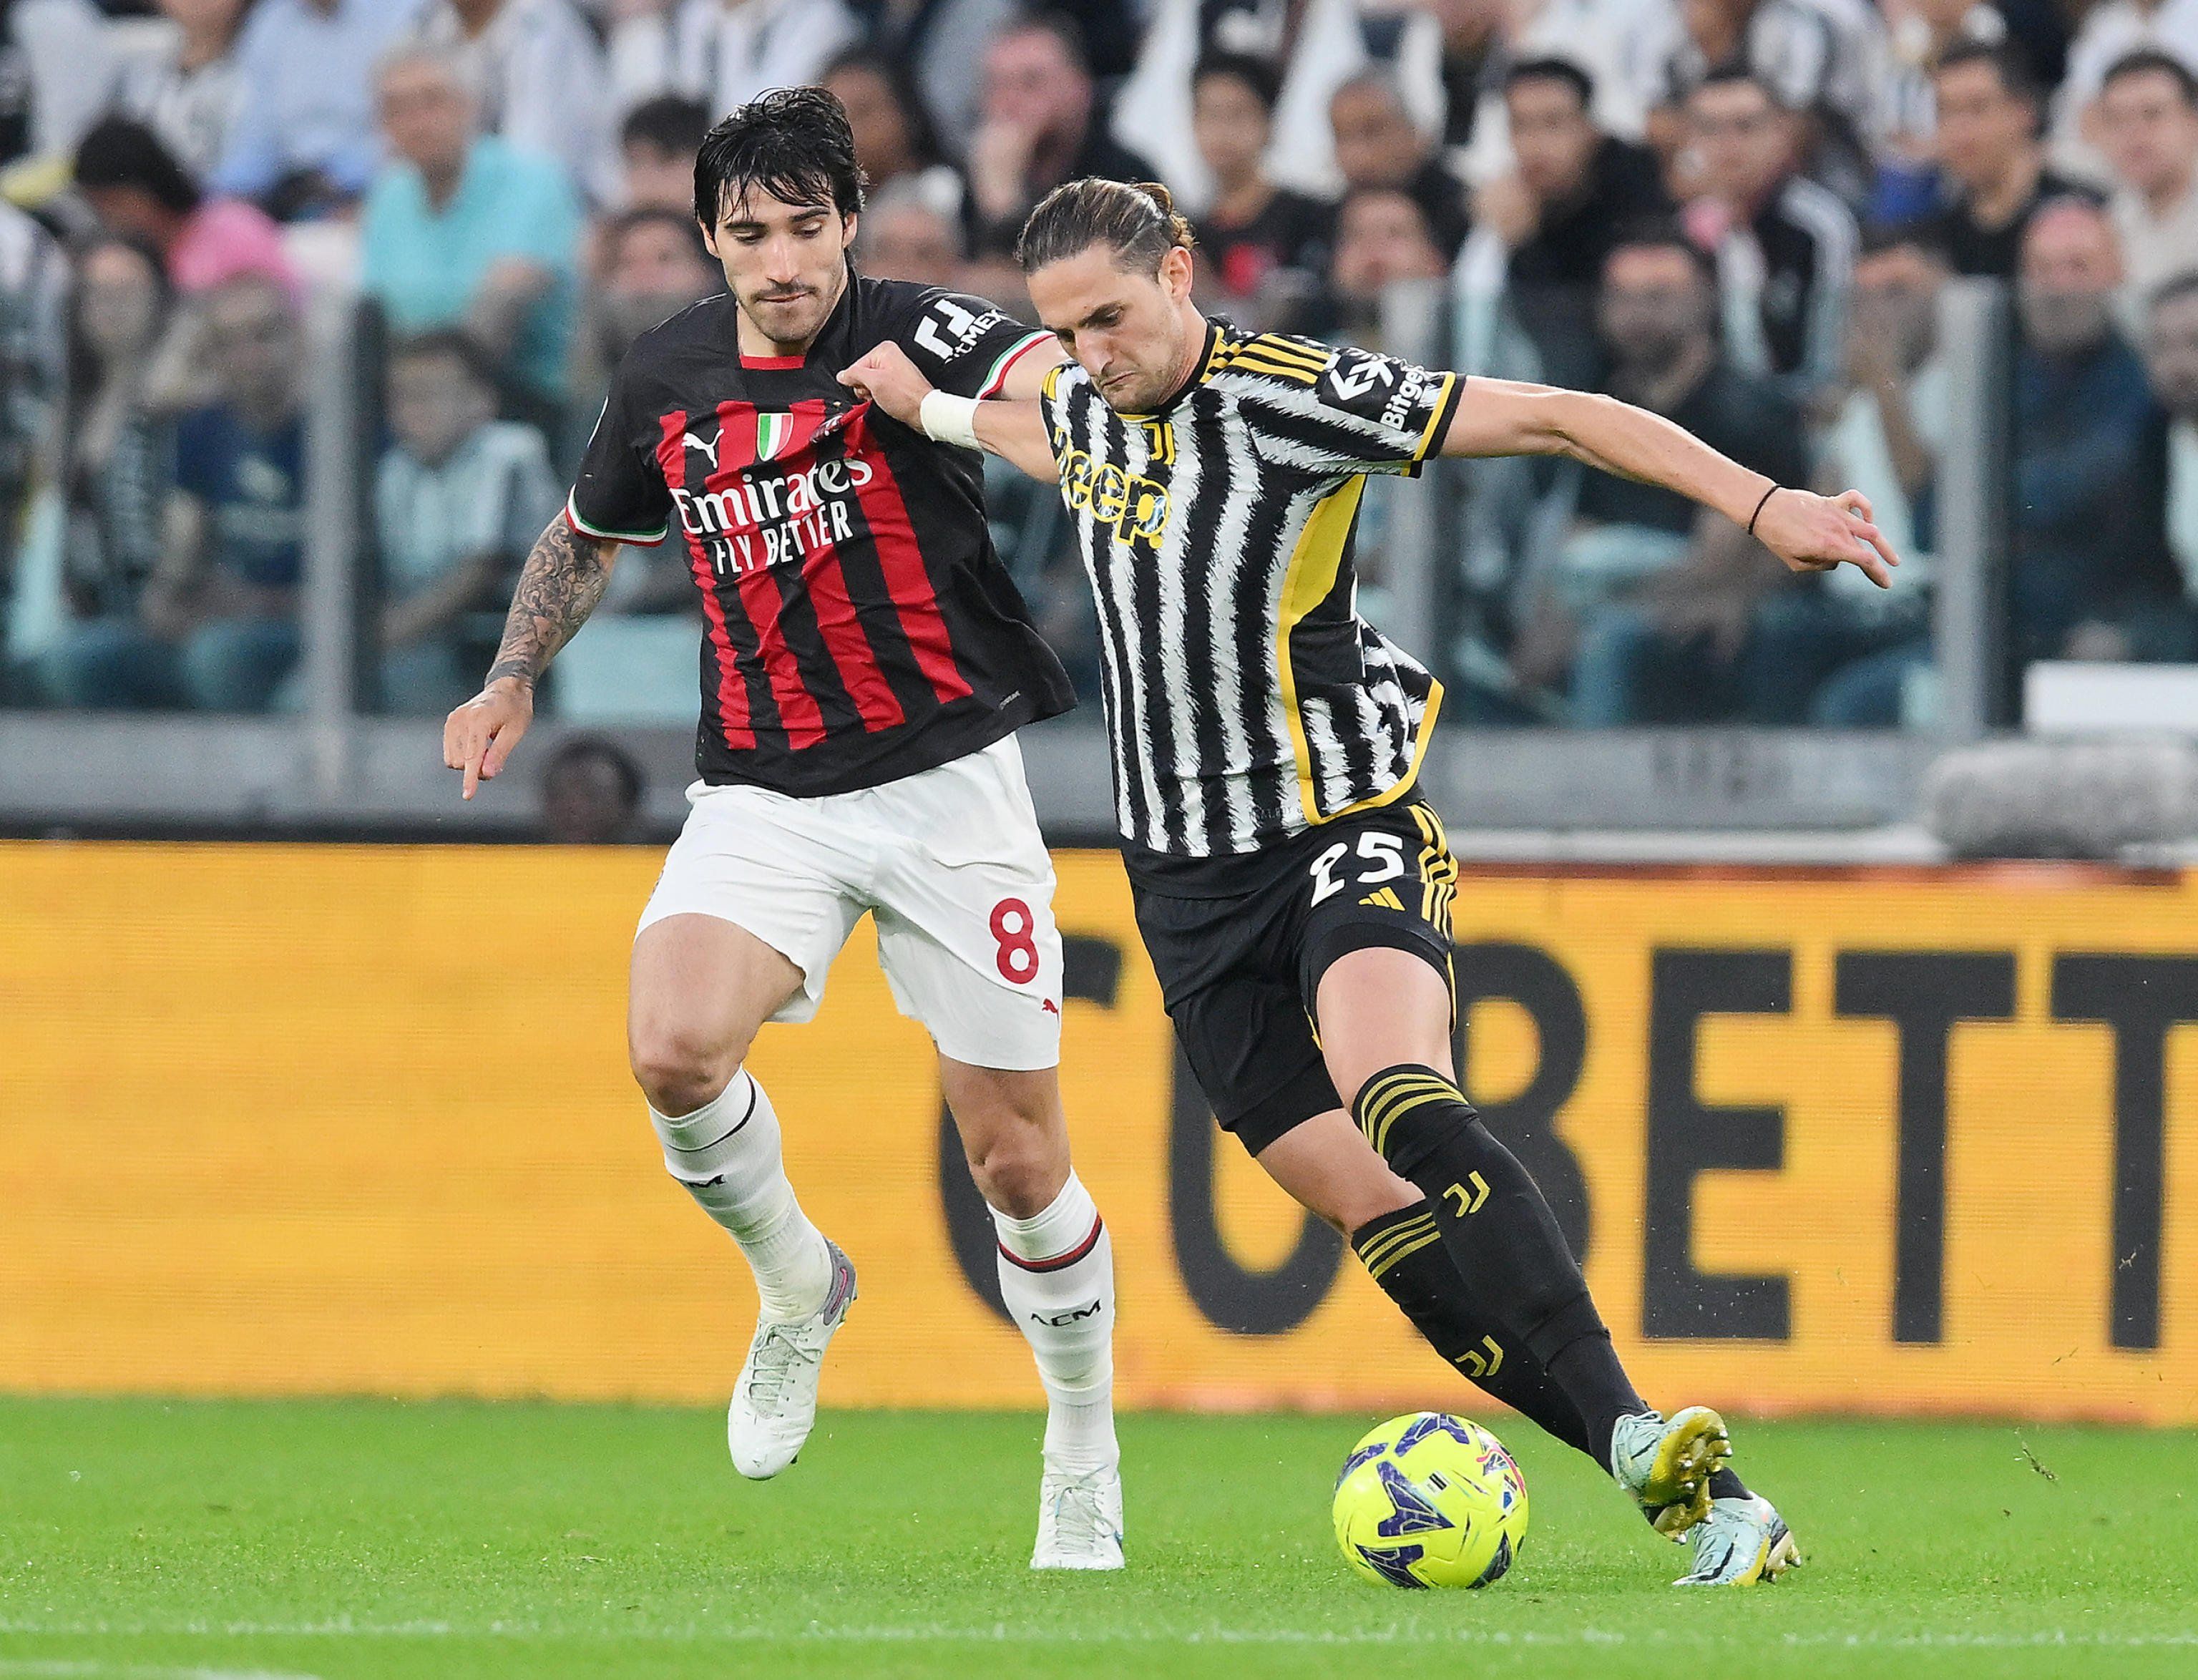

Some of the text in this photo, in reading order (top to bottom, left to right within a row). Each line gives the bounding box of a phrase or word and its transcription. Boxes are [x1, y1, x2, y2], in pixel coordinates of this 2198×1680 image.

[669, 458, 873, 534] Emirates
[713, 500, 854, 575] FLY BETTER
[1309, 831, 1404, 907] 25
[990, 898, 1039, 984] 8
